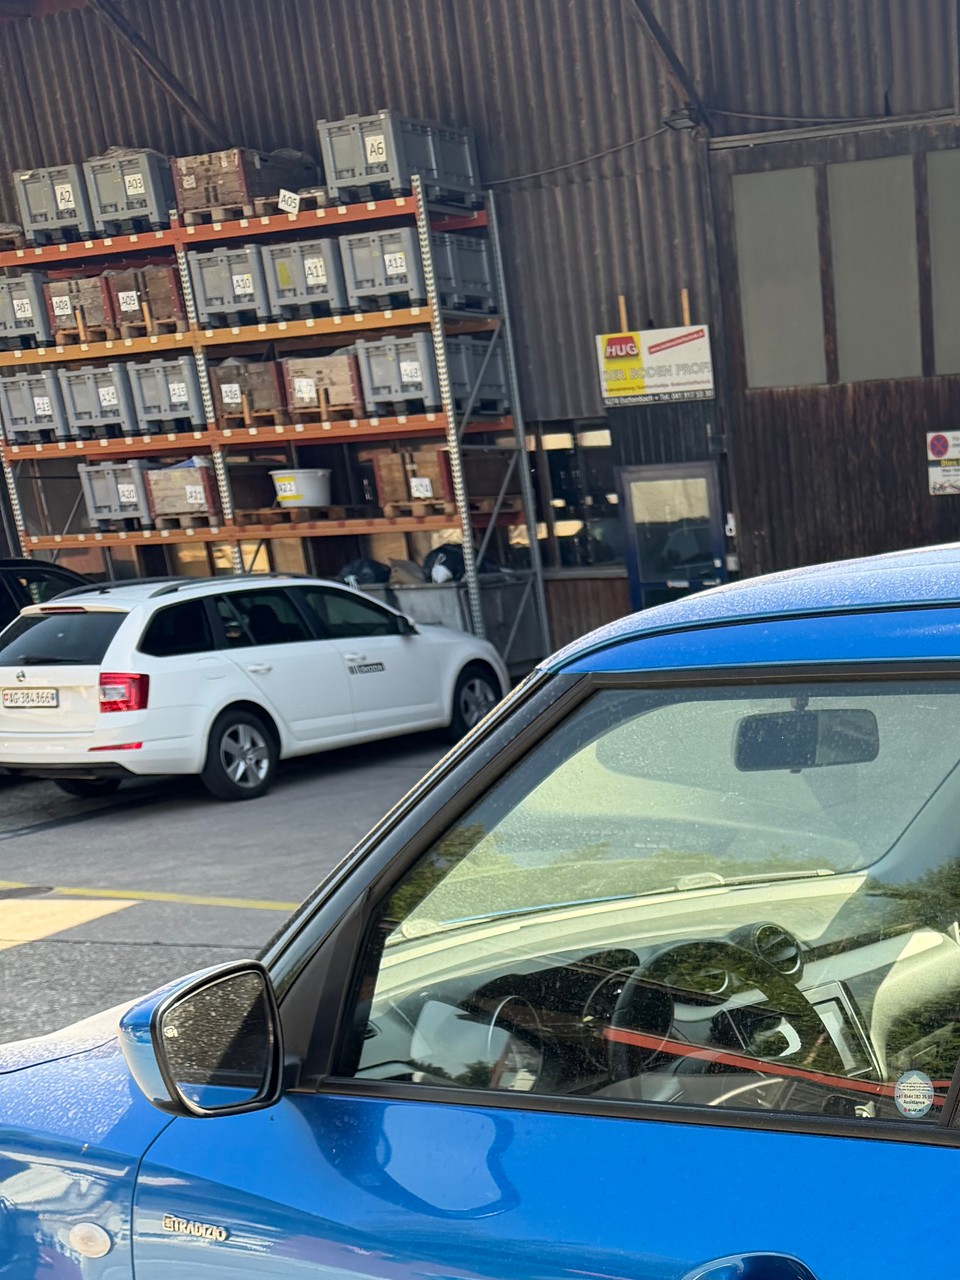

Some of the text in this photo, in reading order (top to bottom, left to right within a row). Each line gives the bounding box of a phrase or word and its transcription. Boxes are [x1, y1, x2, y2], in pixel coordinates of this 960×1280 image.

[368, 141, 384, 156] A6
[127, 179, 143, 190] A03
[59, 190, 73, 203] A2
[280, 195, 298, 210] A05
[387, 257, 404, 269] A12
[235, 277, 251, 290] A10
[121, 295, 136, 307] A09
[605, 343, 639, 357] HUG
[630, 364, 672, 379] BODEN
[172, 1217, 227, 1242] TRADIZIO
